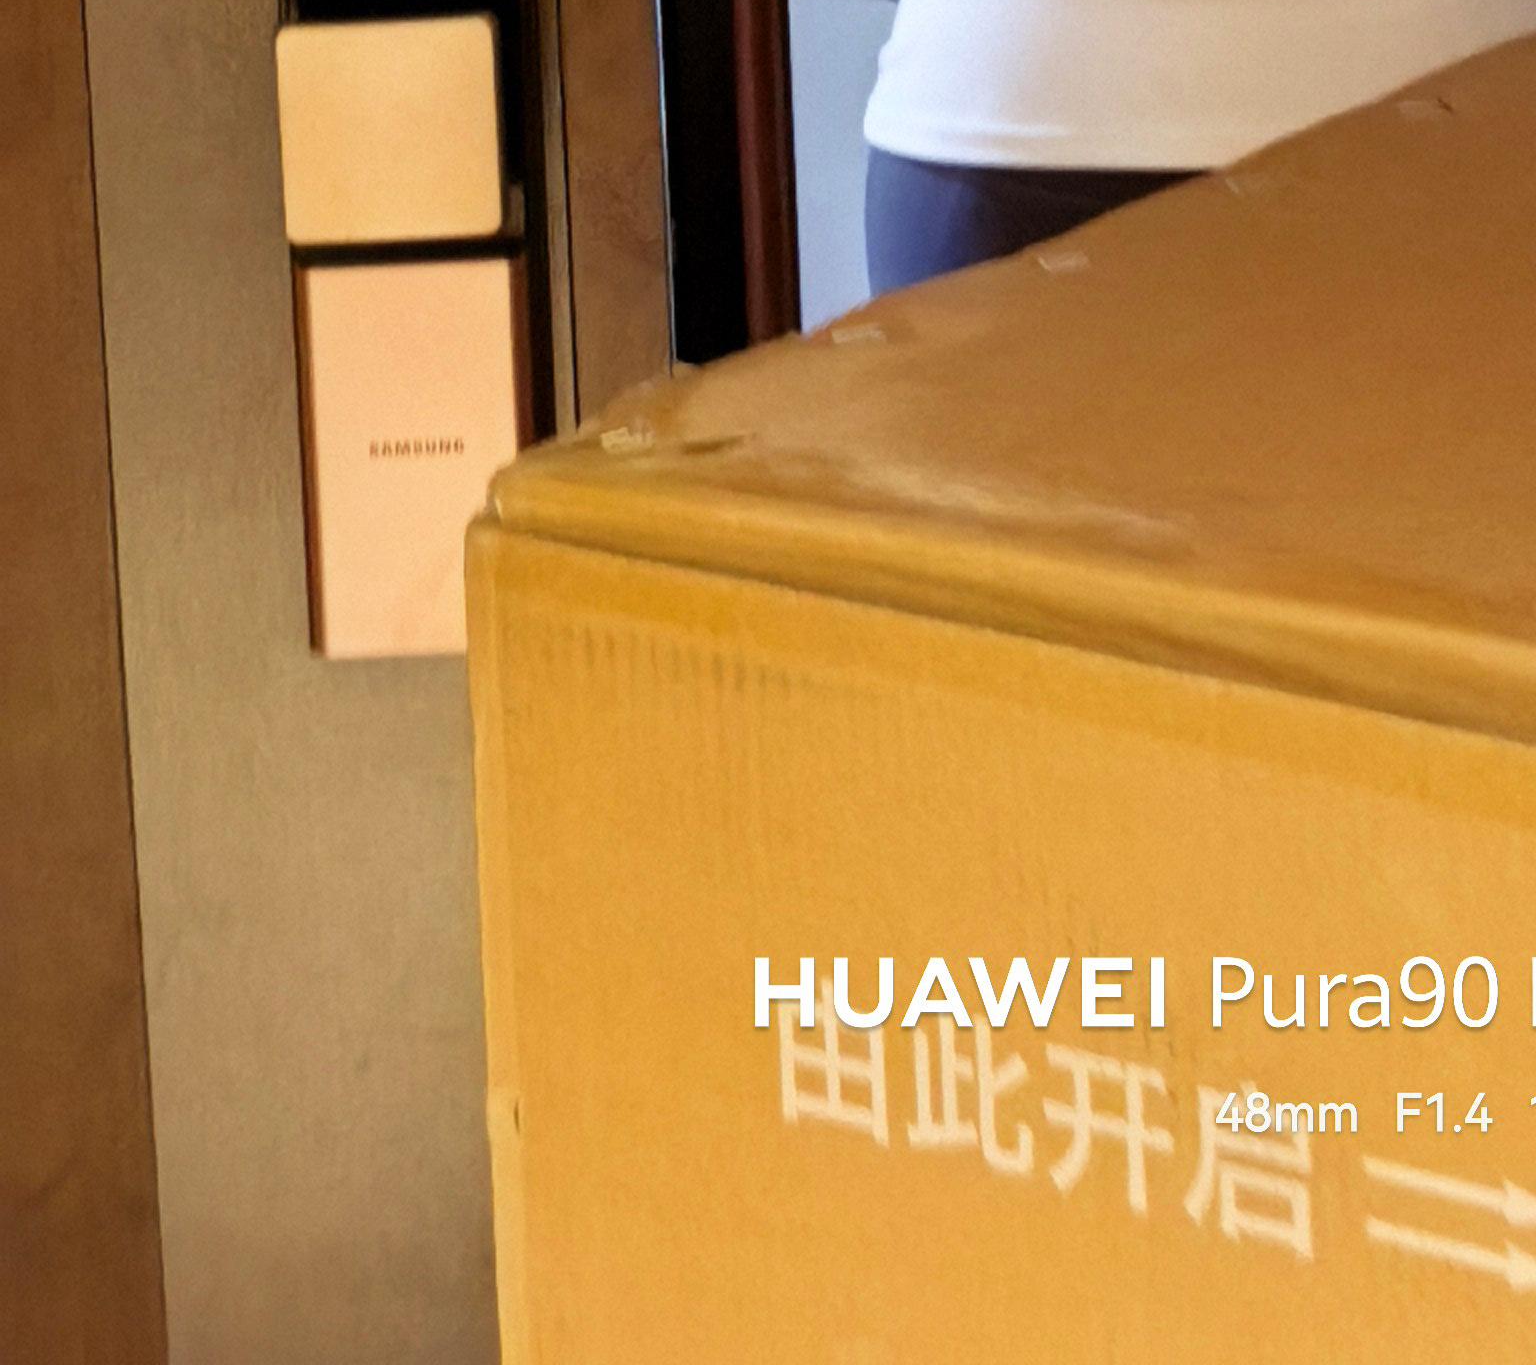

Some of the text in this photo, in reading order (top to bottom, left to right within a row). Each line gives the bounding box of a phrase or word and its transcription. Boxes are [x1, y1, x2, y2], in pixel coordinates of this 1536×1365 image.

[368, 438, 465, 459] SAMSUNG
[777, 976, 1315, 1262] 由此开启
